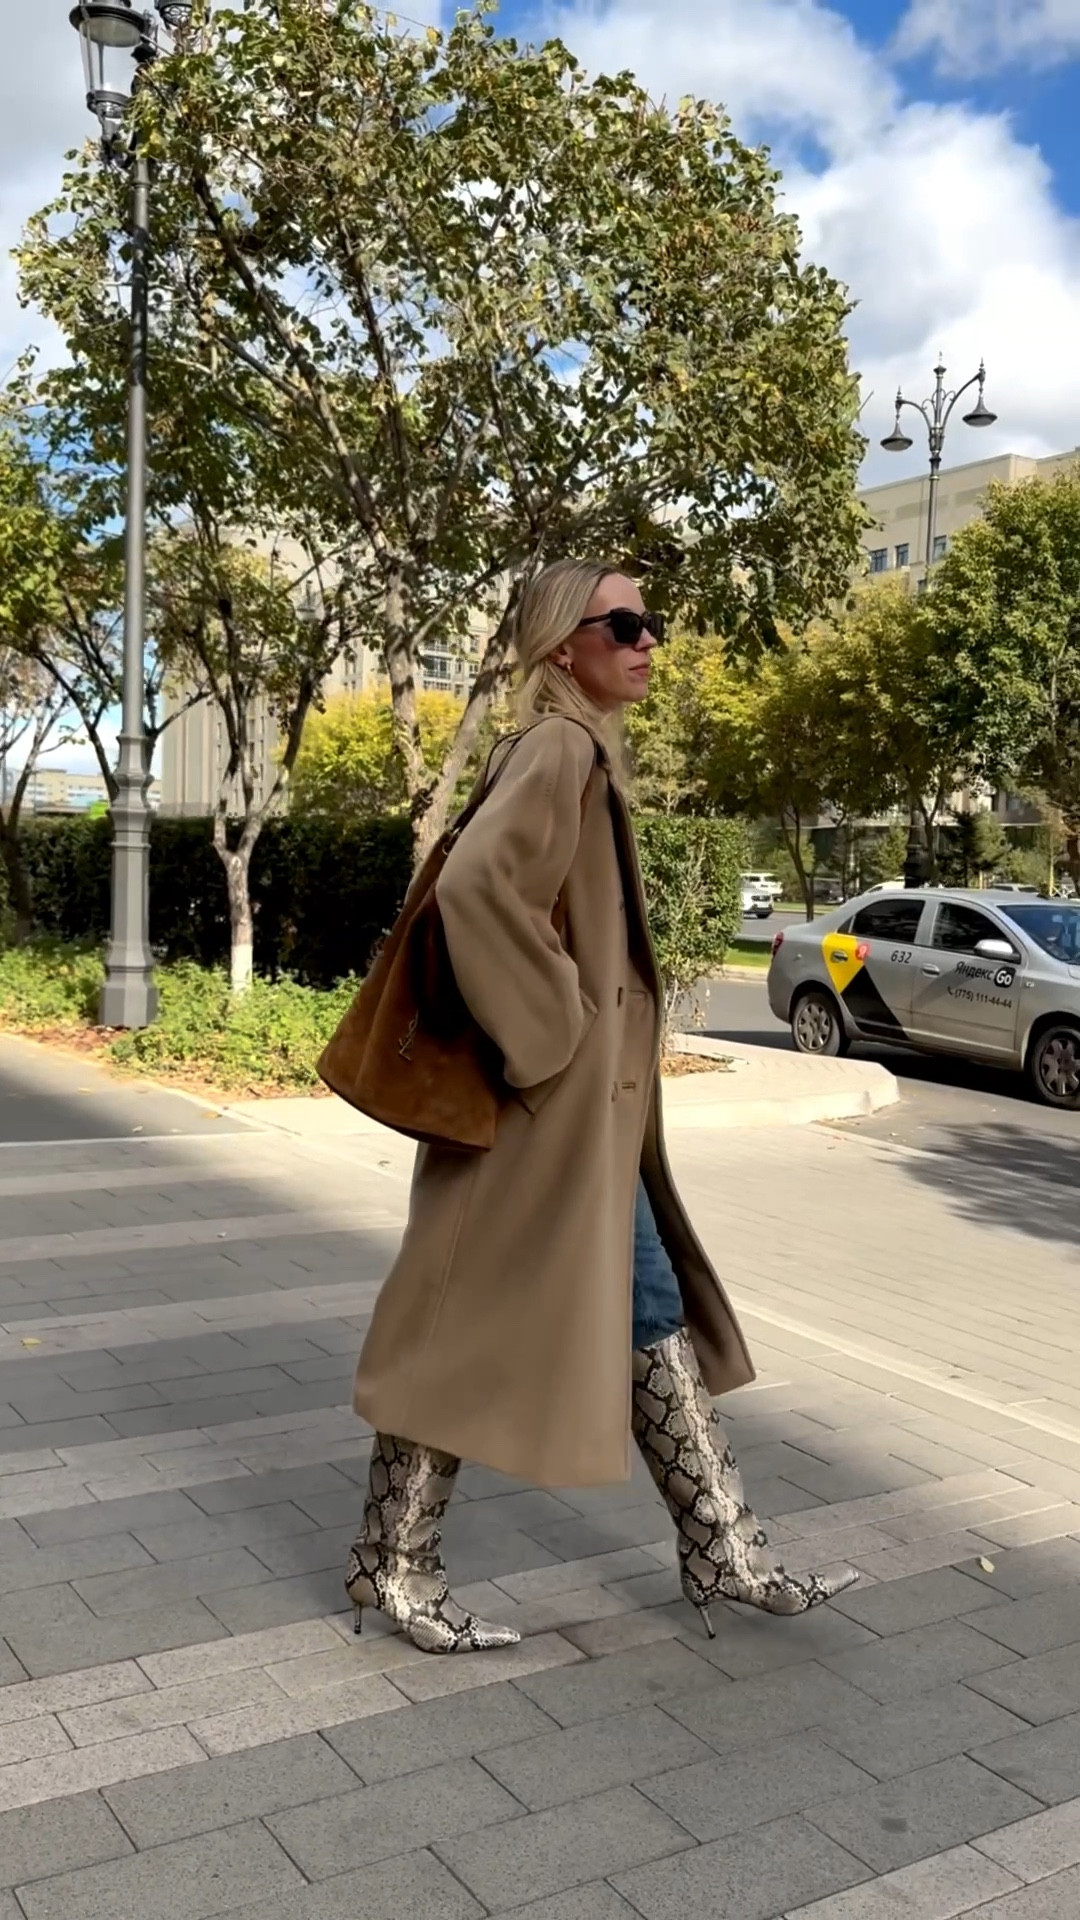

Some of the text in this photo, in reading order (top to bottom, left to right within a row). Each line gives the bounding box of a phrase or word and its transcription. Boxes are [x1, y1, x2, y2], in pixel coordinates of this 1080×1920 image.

[890, 950, 912, 964] 632
[955, 961, 1012, 985] Яндекс Go
[954, 988, 1012, 1008] (775) 111-44-44
